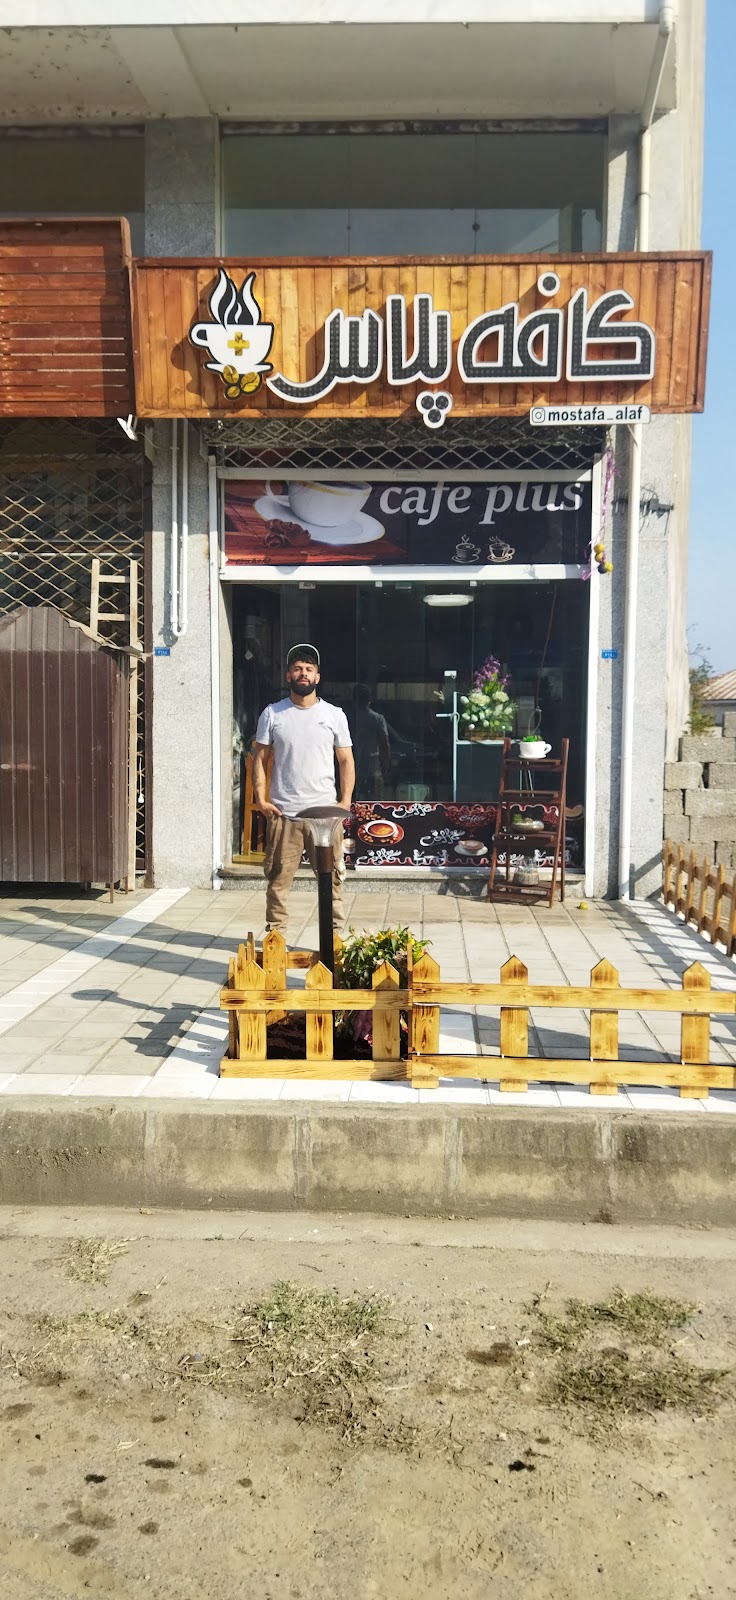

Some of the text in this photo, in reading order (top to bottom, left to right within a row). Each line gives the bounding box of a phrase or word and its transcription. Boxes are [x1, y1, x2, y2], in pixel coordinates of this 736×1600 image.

[266, 271, 655, 428] کافه پلاس
[548, 405, 643, 421] mostafa_alaf
[479, 482, 584, 525] plus
